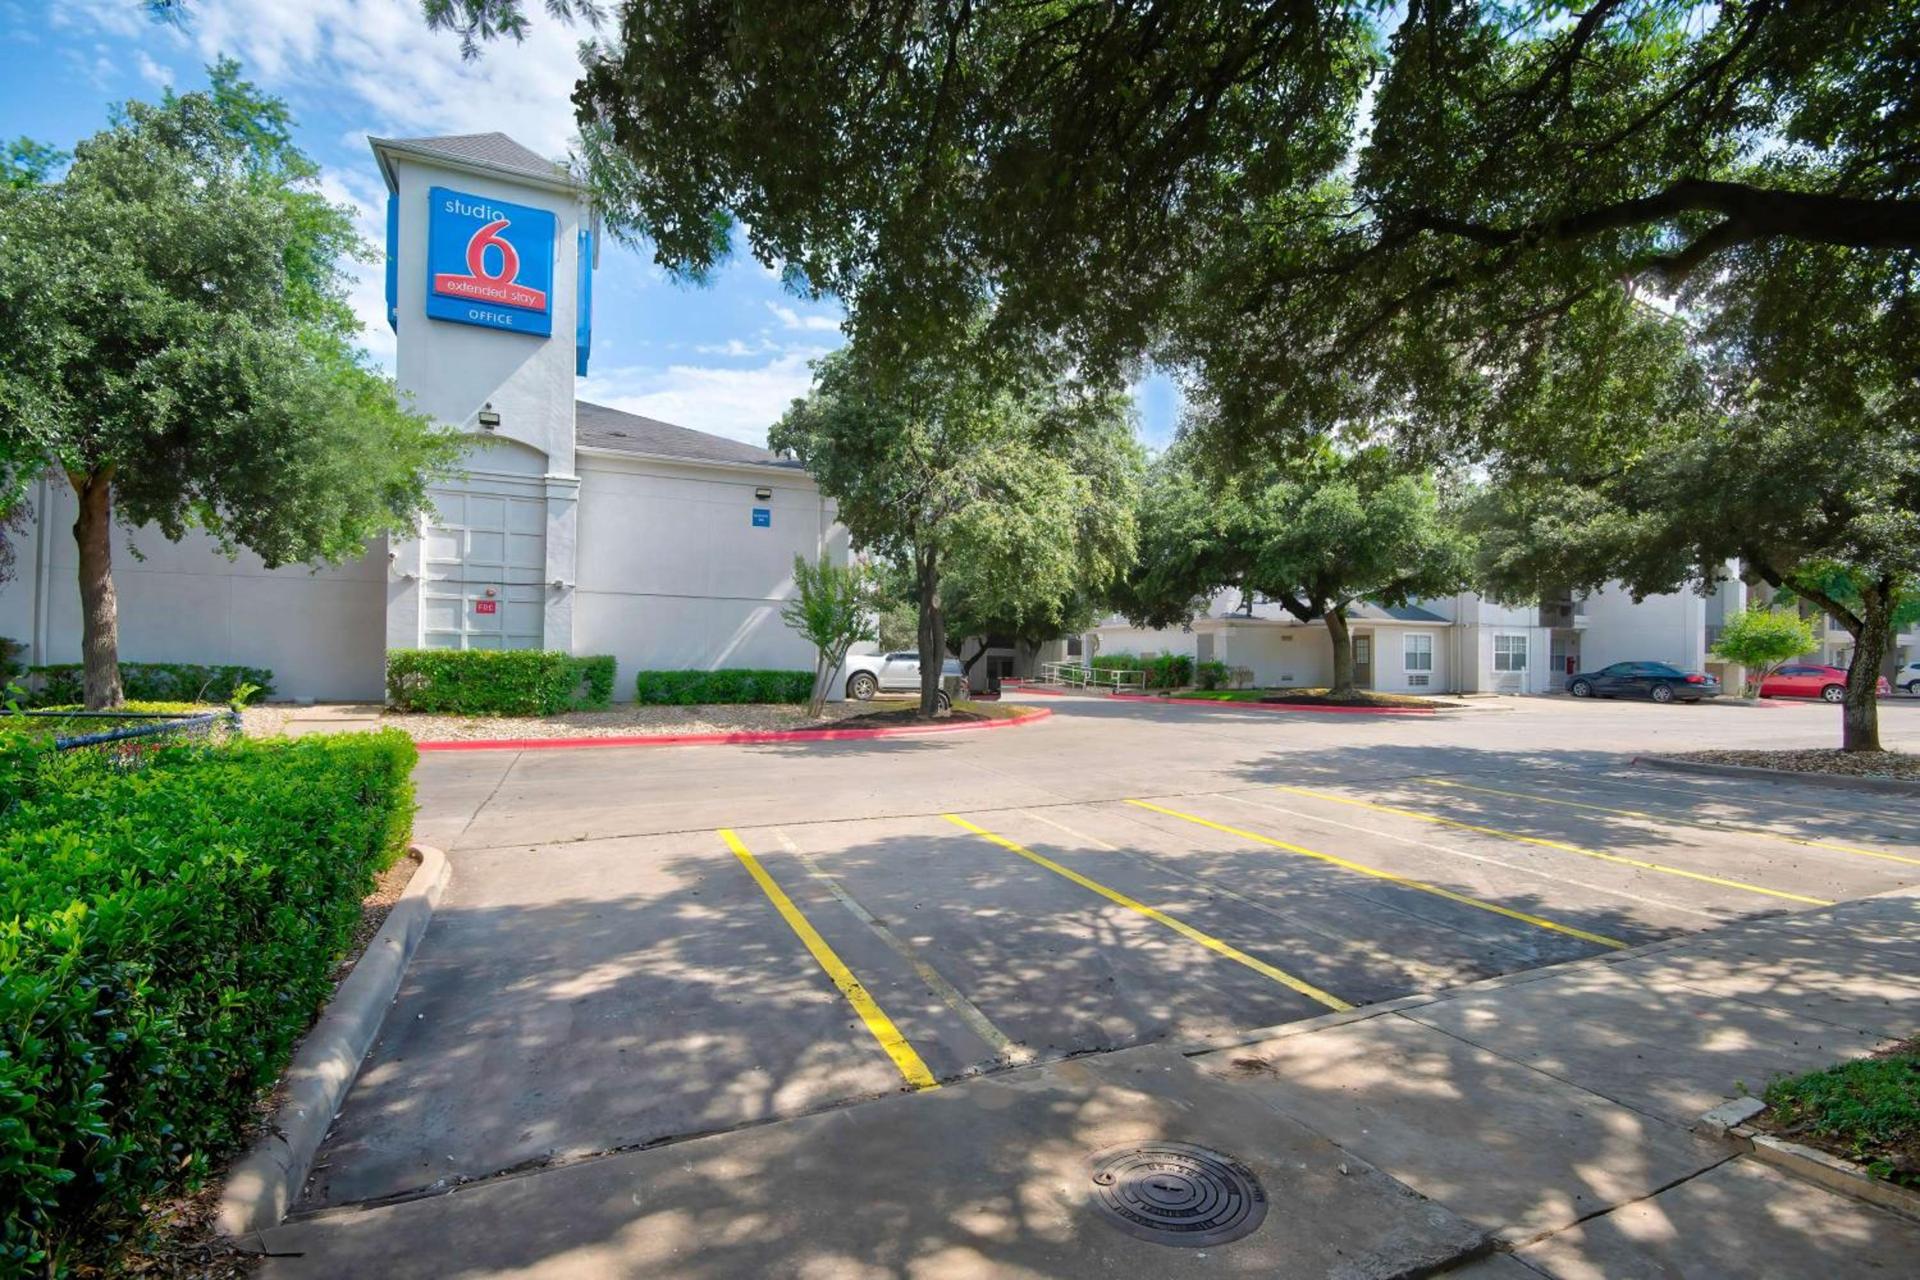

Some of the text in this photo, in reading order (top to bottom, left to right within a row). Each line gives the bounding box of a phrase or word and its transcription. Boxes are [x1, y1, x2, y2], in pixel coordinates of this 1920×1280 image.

[445, 200, 505, 220] studio
[466, 219, 519, 284] 6
[447, 281, 537, 306] extended stay
[469, 309, 512, 324] OFFICE
